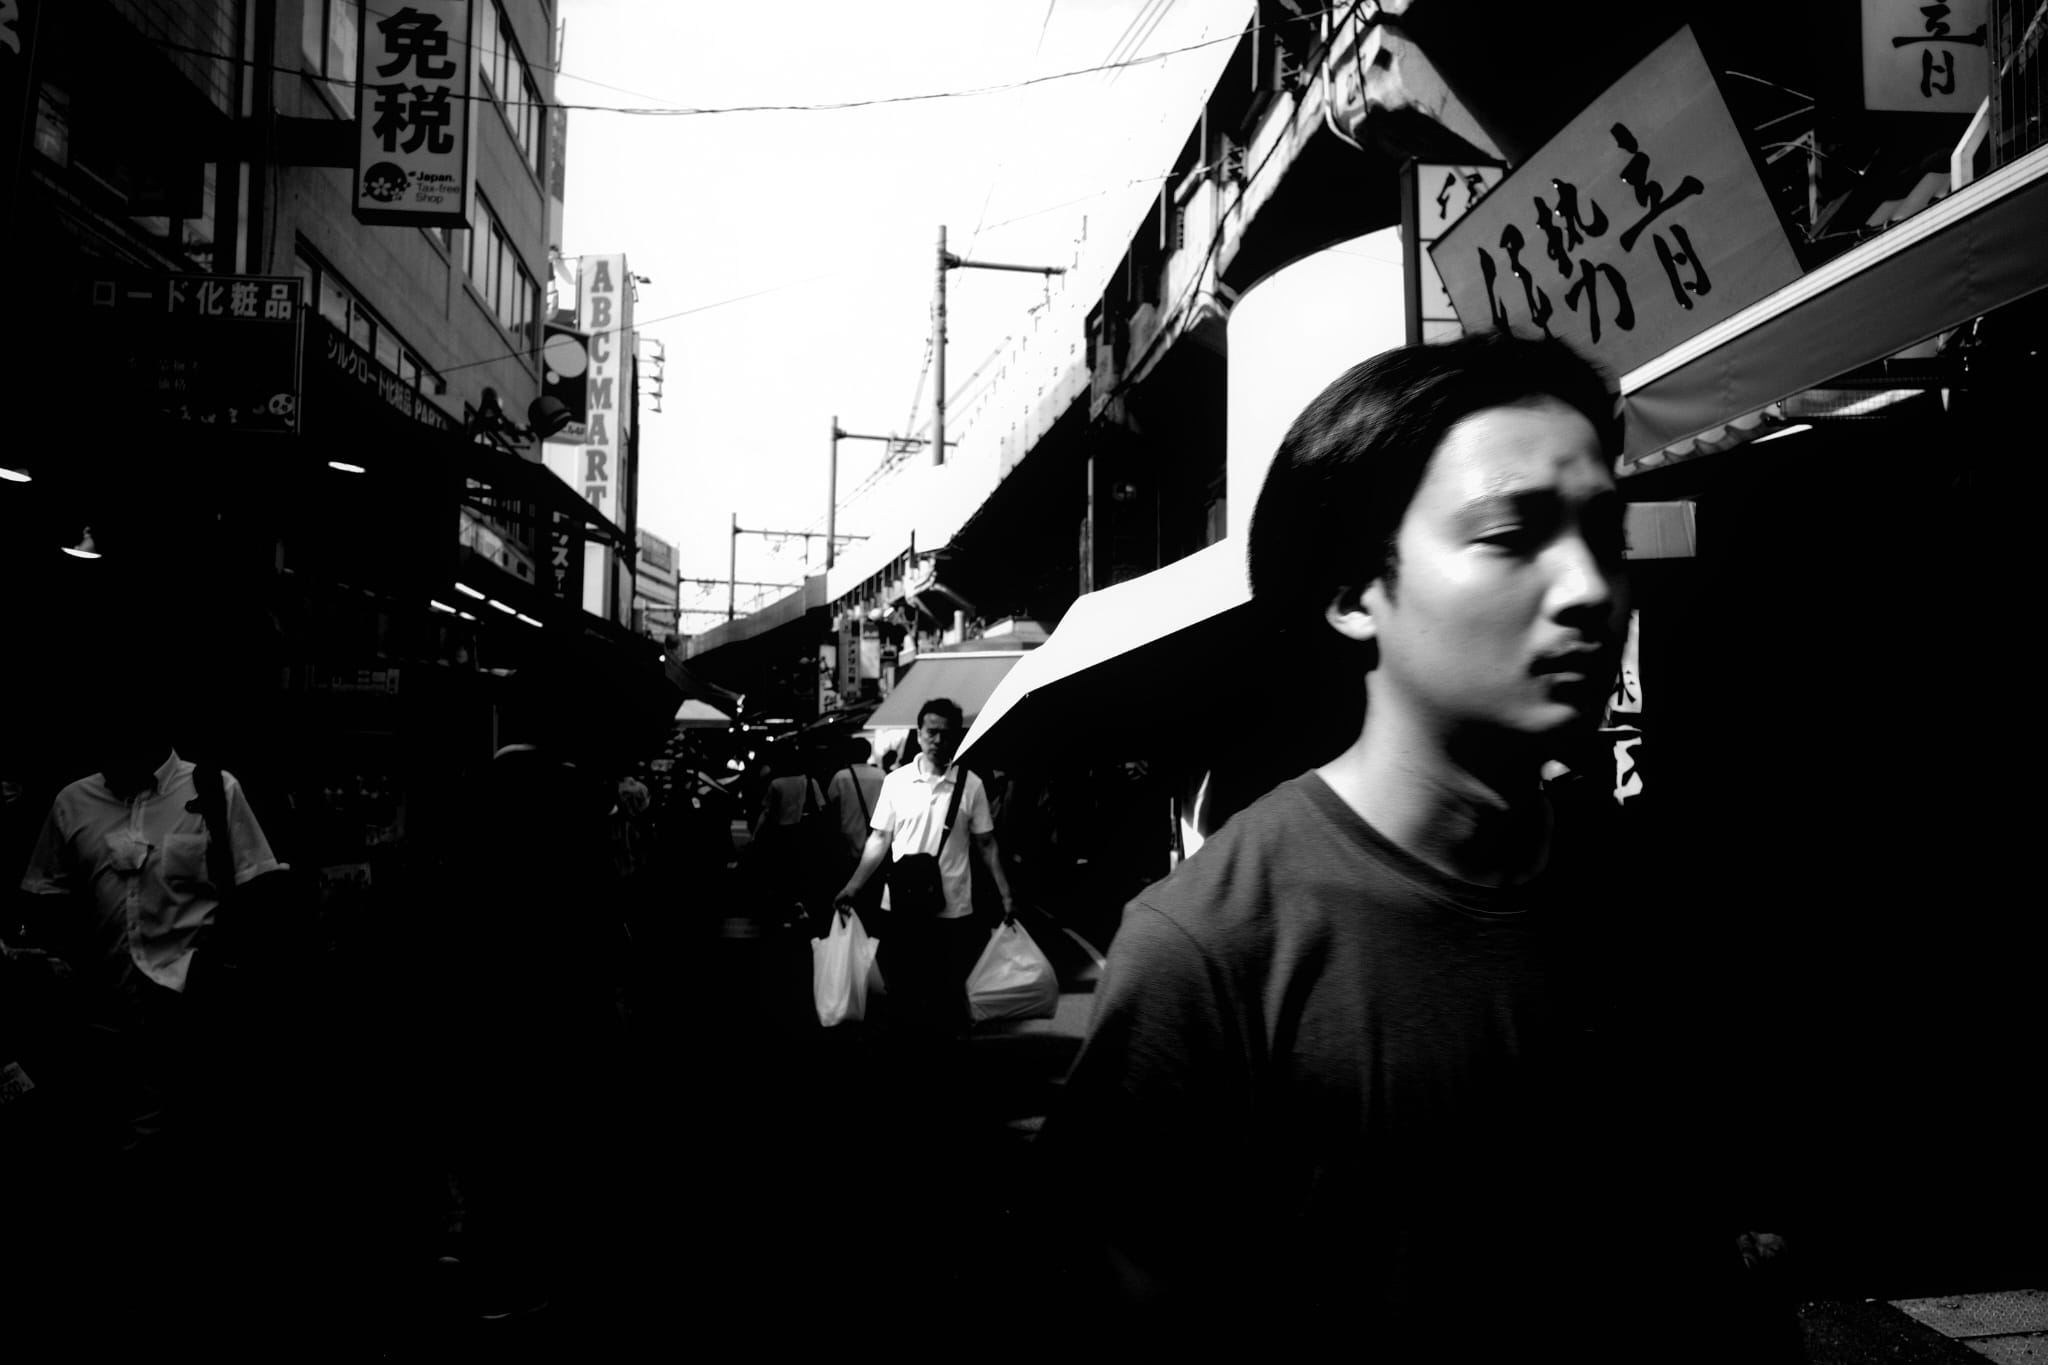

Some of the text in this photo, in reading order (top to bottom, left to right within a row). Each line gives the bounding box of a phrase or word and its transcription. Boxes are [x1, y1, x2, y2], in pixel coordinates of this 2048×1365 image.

[373, 7, 456, 154] 免税
[416, 192, 444, 205] Shop
[417, 182, 460, 193] Tax-free
[92, 279, 293, 320] ロード化粧品
